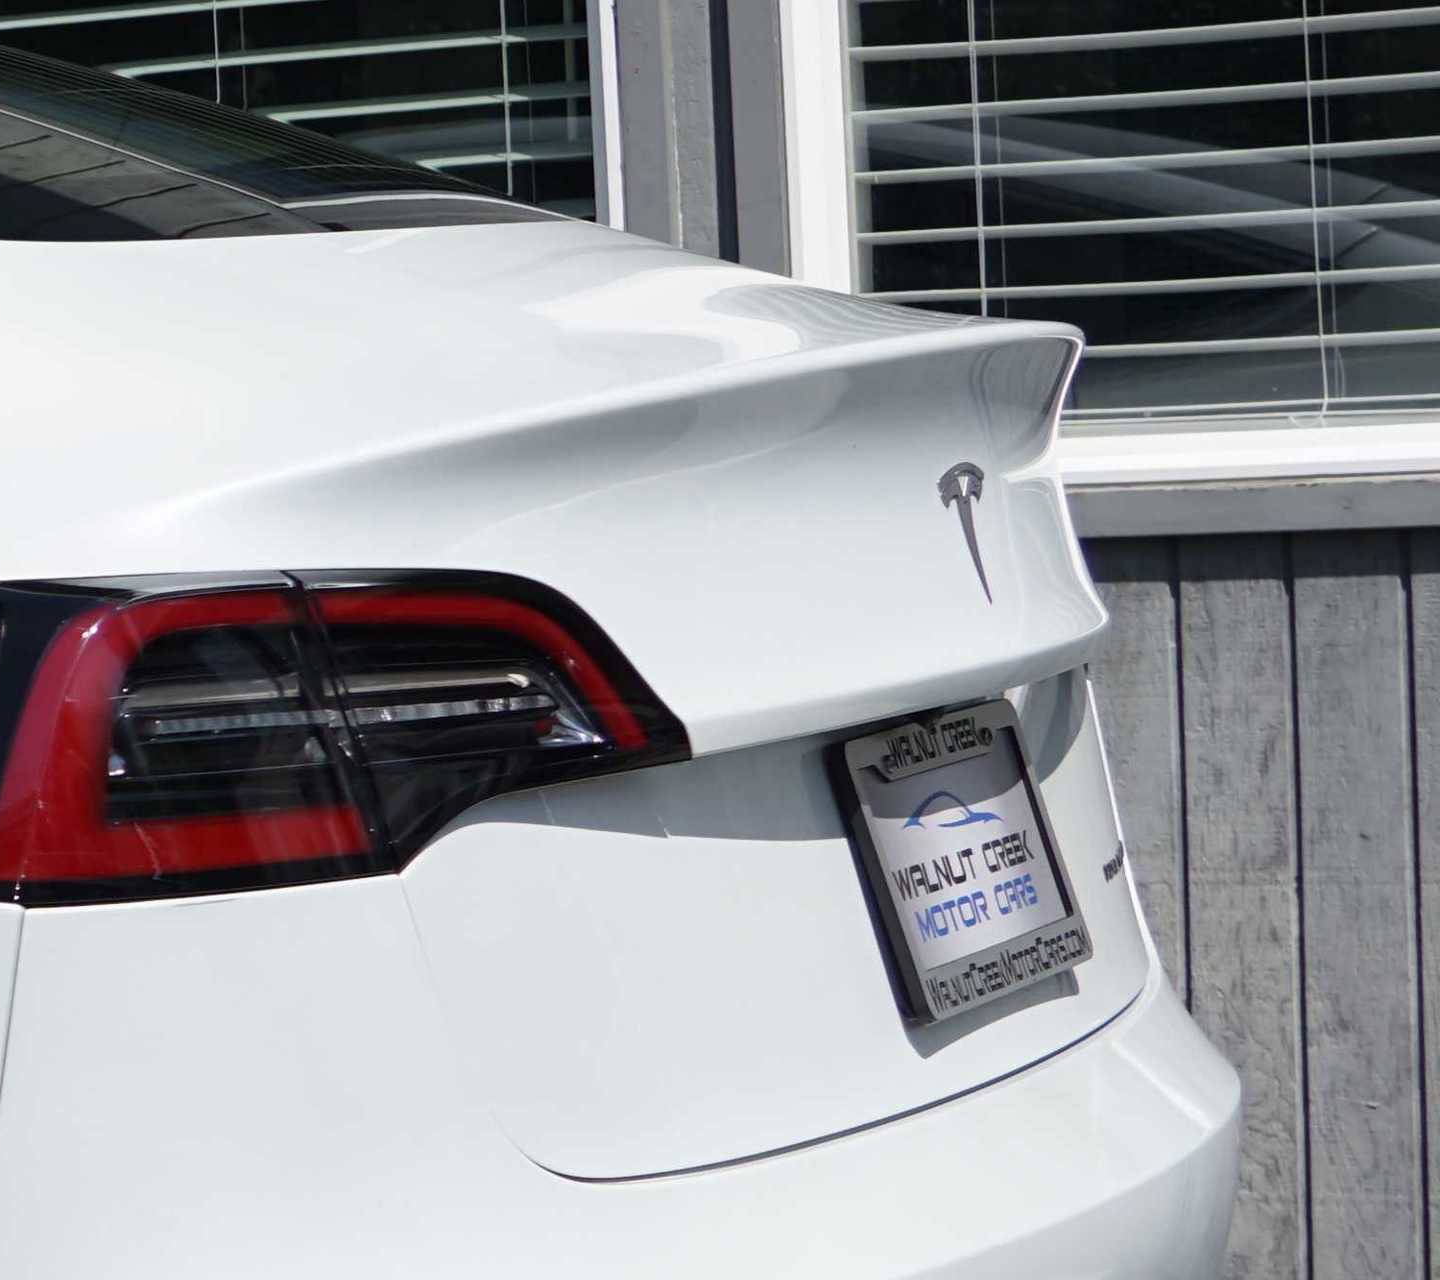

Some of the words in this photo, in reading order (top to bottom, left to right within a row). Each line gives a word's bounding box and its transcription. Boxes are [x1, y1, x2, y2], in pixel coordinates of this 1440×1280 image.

[886, 722, 941, 769] WALNUT
[941, 716, 981, 753] CREEK
[891, 847, 976, 901] WALNUT
[981, 829, 1034, 873] CREEK
[914, 890, 991, 942] MOTOR
[994, 873, 1038, 915] CARS
